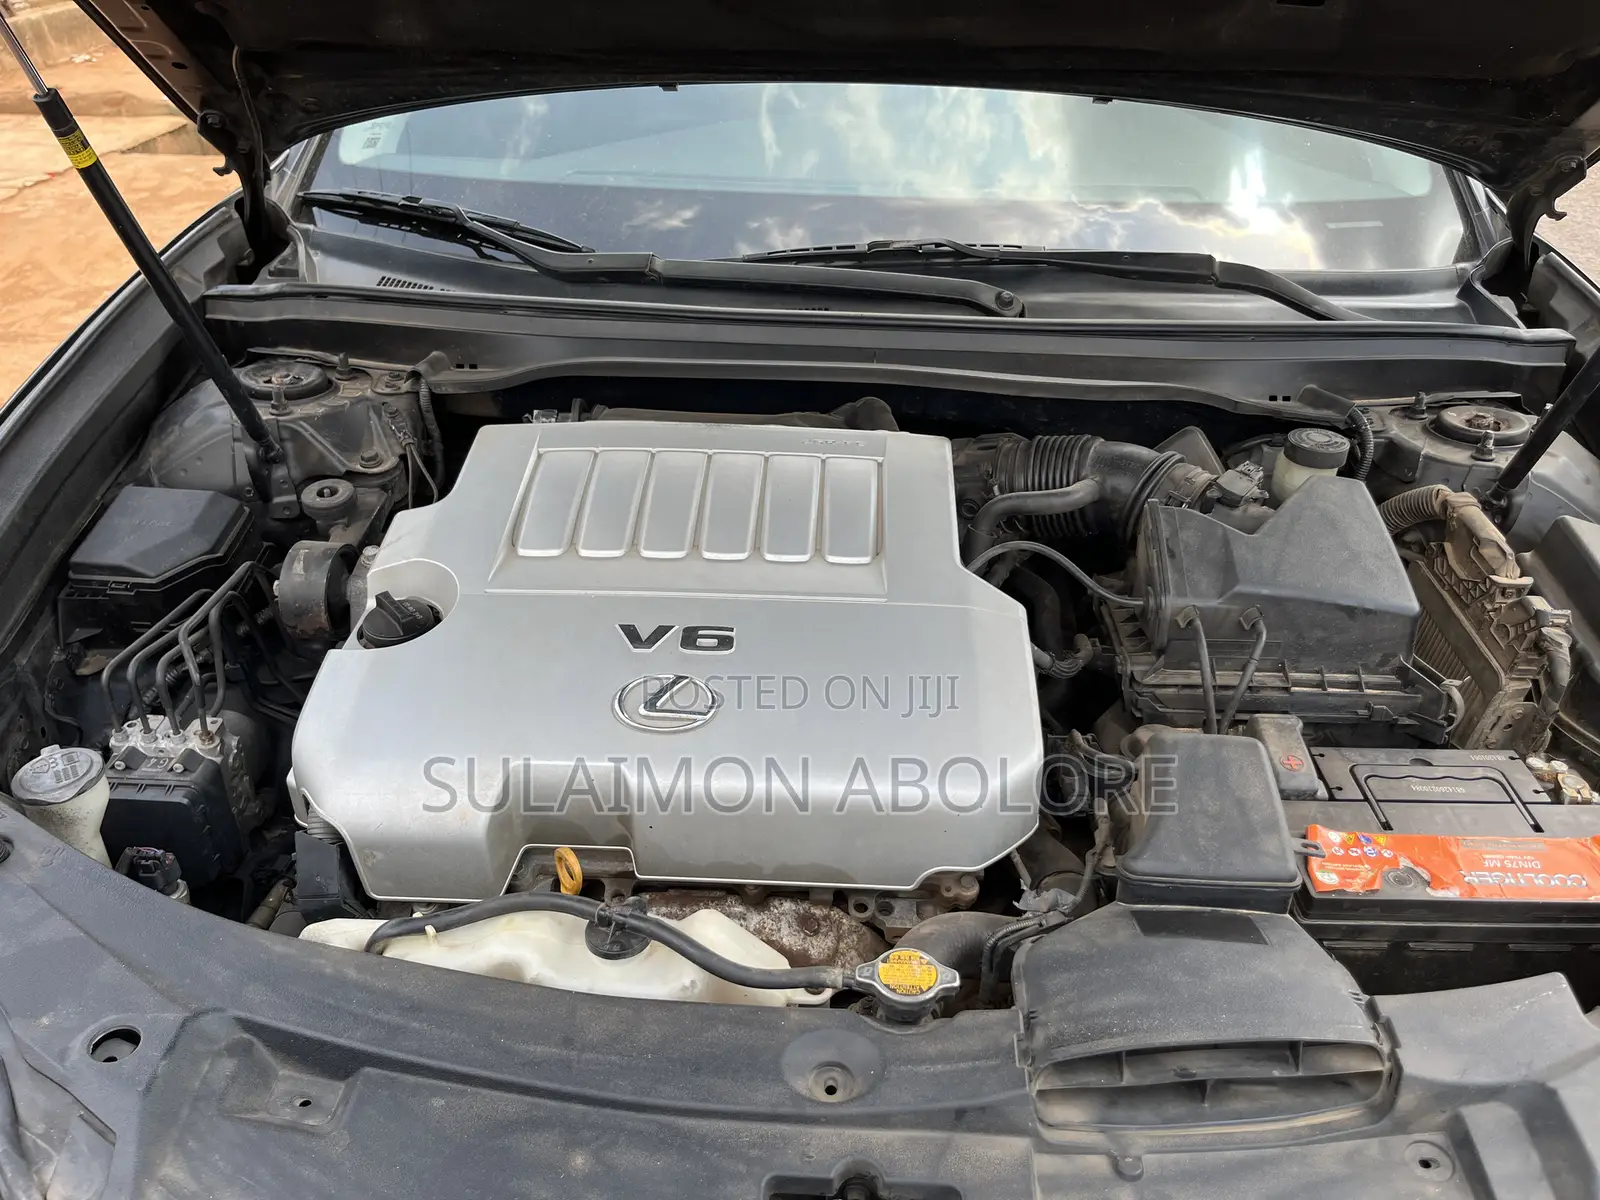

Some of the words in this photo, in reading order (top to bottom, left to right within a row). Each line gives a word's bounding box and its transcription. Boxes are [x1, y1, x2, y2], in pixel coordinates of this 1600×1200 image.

[615, 623, 736, 655] V6
[1483, 859, 1501, 868] MF
[1503, 859, 1542, 869] DIN75
